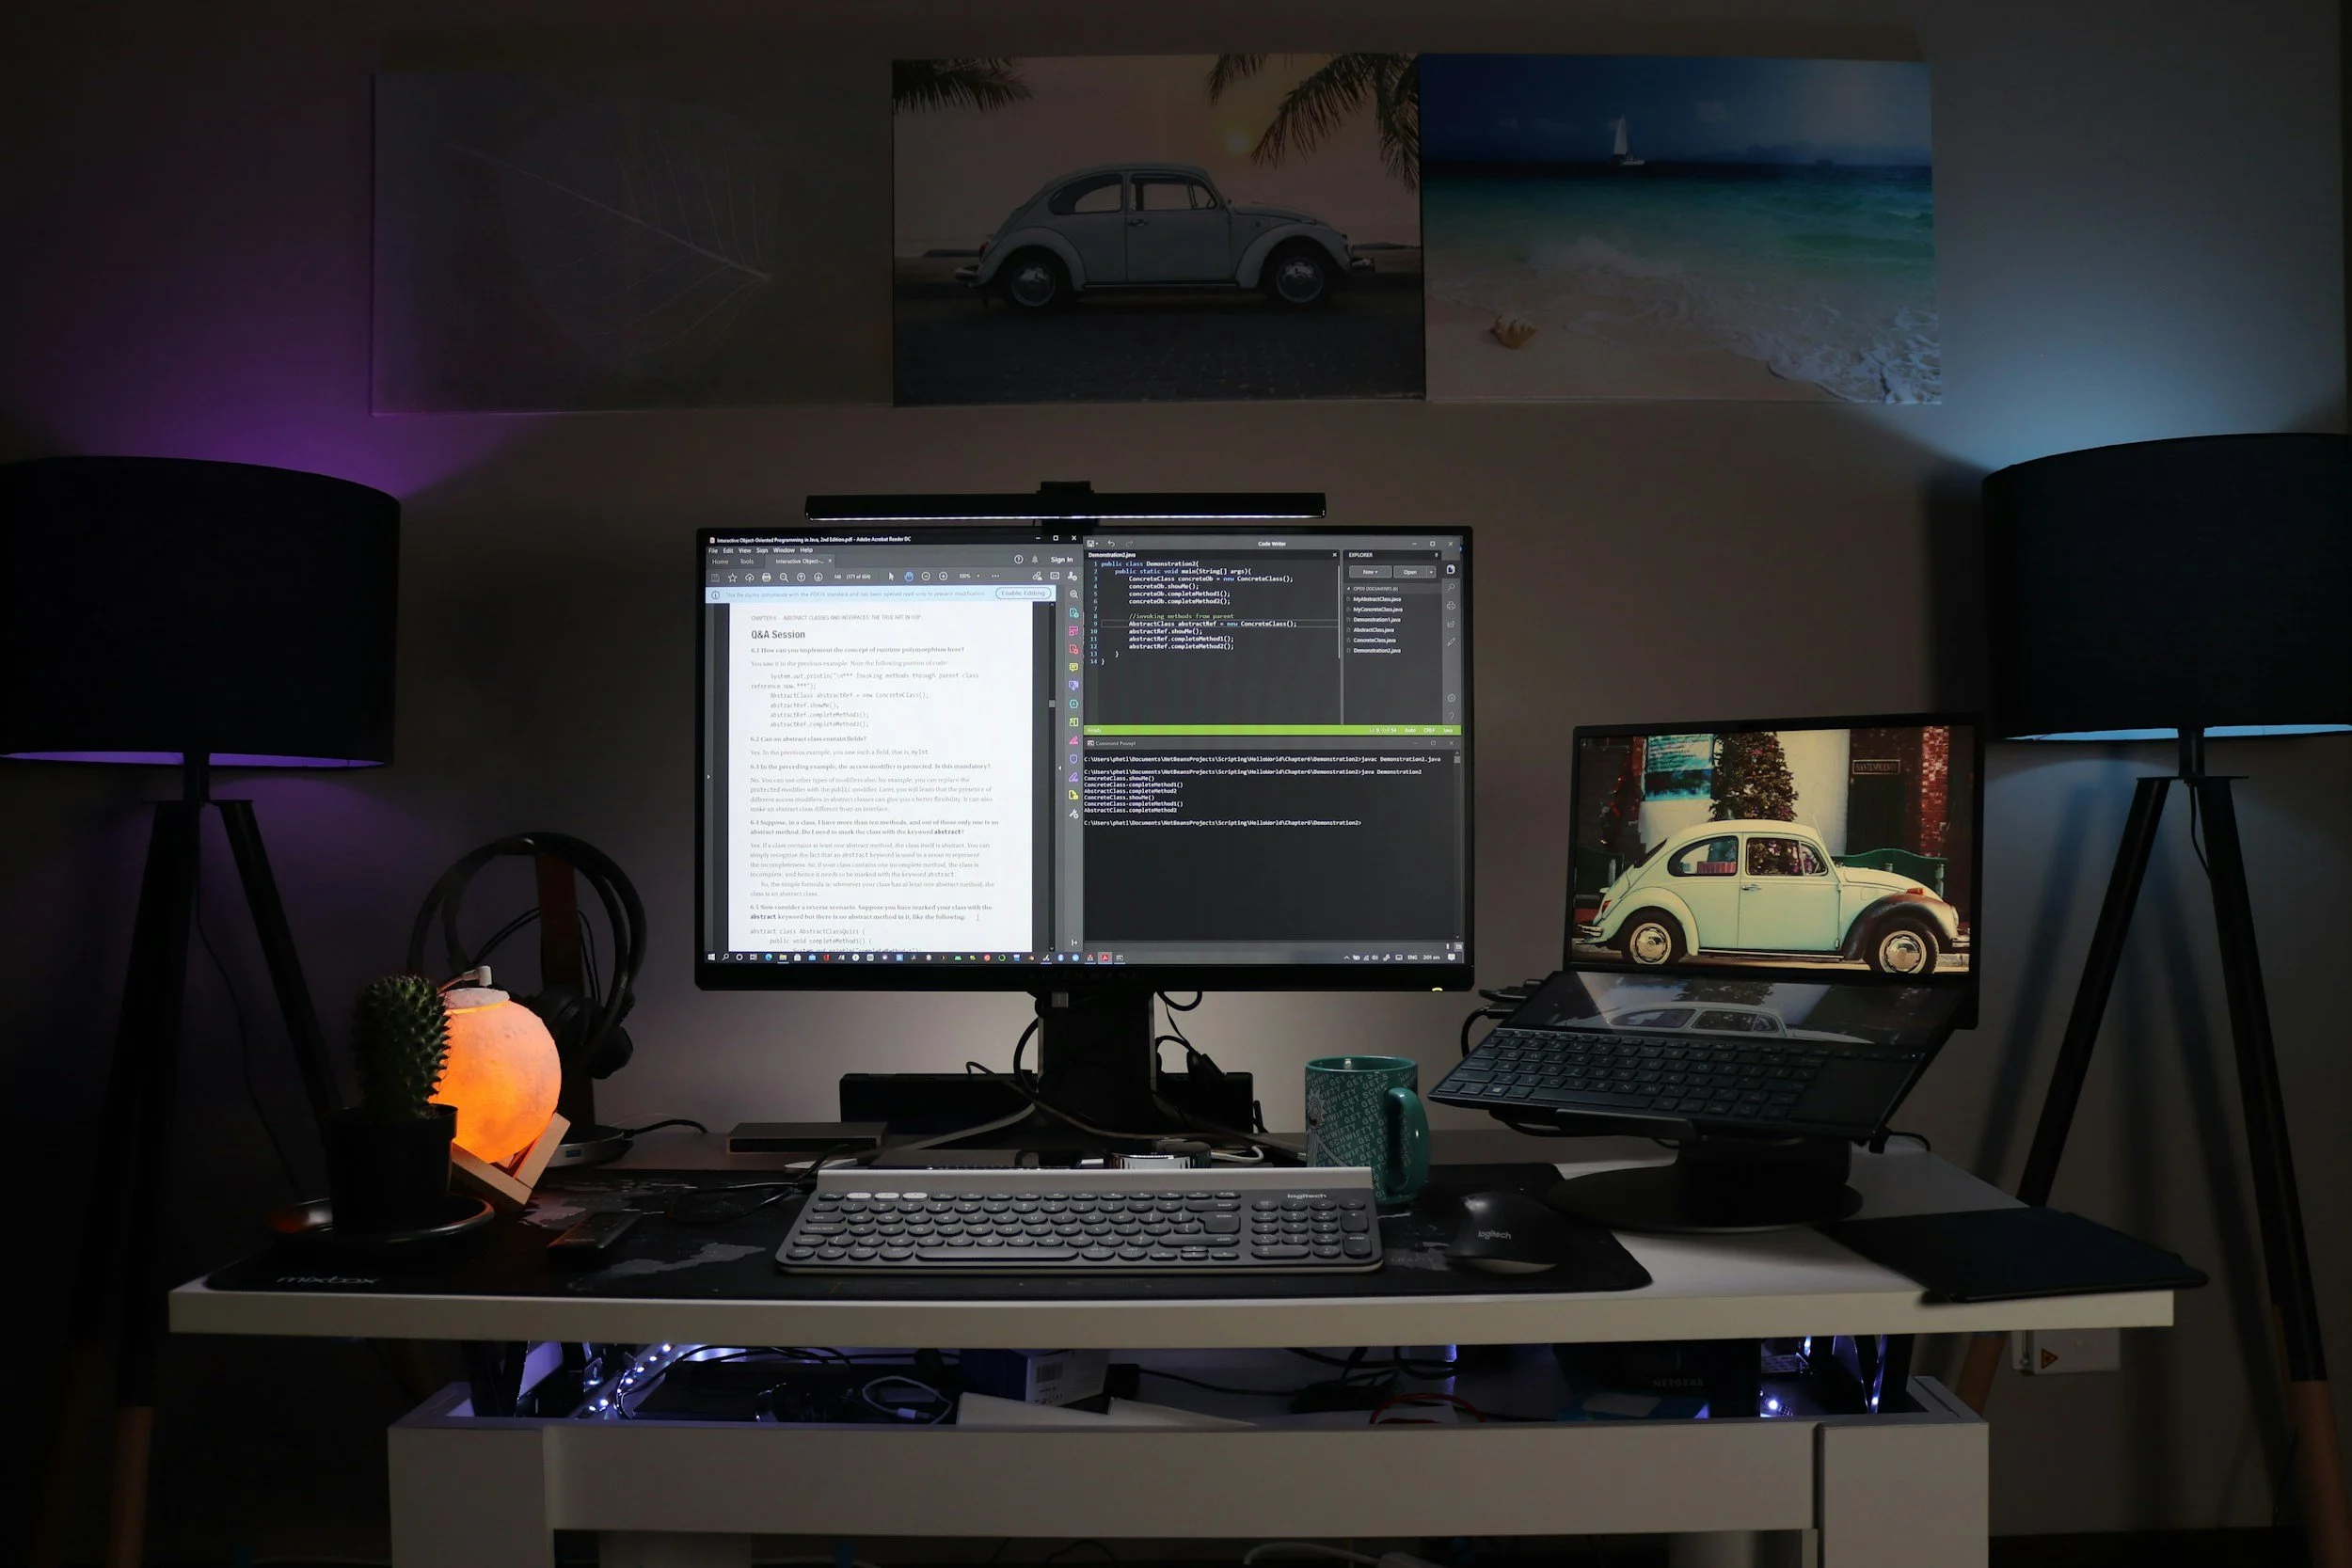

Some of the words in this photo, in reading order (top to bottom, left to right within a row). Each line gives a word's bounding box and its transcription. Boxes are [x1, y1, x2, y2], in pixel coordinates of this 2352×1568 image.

[1051, 556, 1066, 564] Sign
[751, 630, 770, 640] Q&A
[771, 629, 805, 639] Session
[1329, 1074, 1346, 1086] GET
[1346, 1074, 1364, 1088] GET
[1362, 1077, 1381, 1090] GET
[1342, 1095, 1360, 1108] GET
[1360, 1095, 1379, 1108] GET
[1343, 1111, 1362, 1124] GET
[1361, 1113, 1380, 1125] GET
[1358, 1132, 1376, 1145] GET
[1359, 1149, 1378, 1162] GET
[1477, 1229, 1512, 1240] logitech
[277, 1275, 380, 1284] mixbox
[1653, 1377, 1705, 1387] NETGEAR
